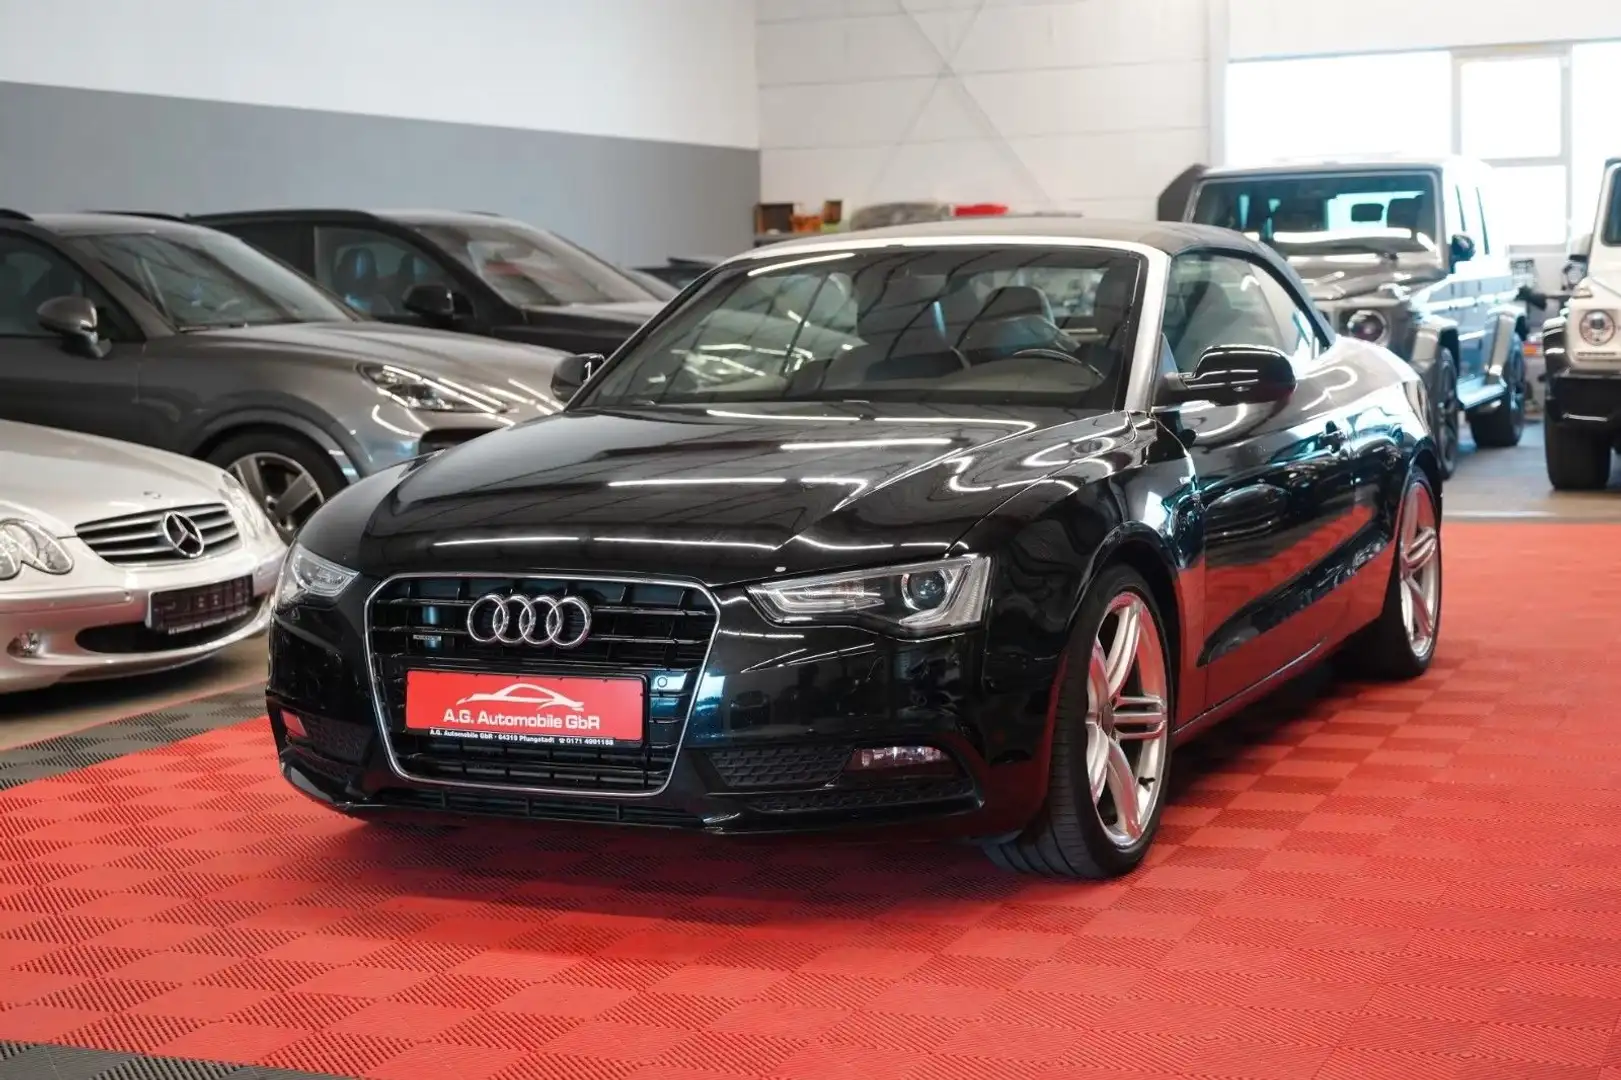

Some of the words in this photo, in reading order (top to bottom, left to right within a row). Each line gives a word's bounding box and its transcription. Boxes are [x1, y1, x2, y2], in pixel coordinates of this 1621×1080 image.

[443, 708, 475, 724] A.G.
[477, 710, 563, 729] Automobile
[565, 714, 600, 730] GbR
[444, 730, 479, 739] Automobile
[480, 732, 494, 740] GbR
[519, 735, 555, 744] Pfungstadt
